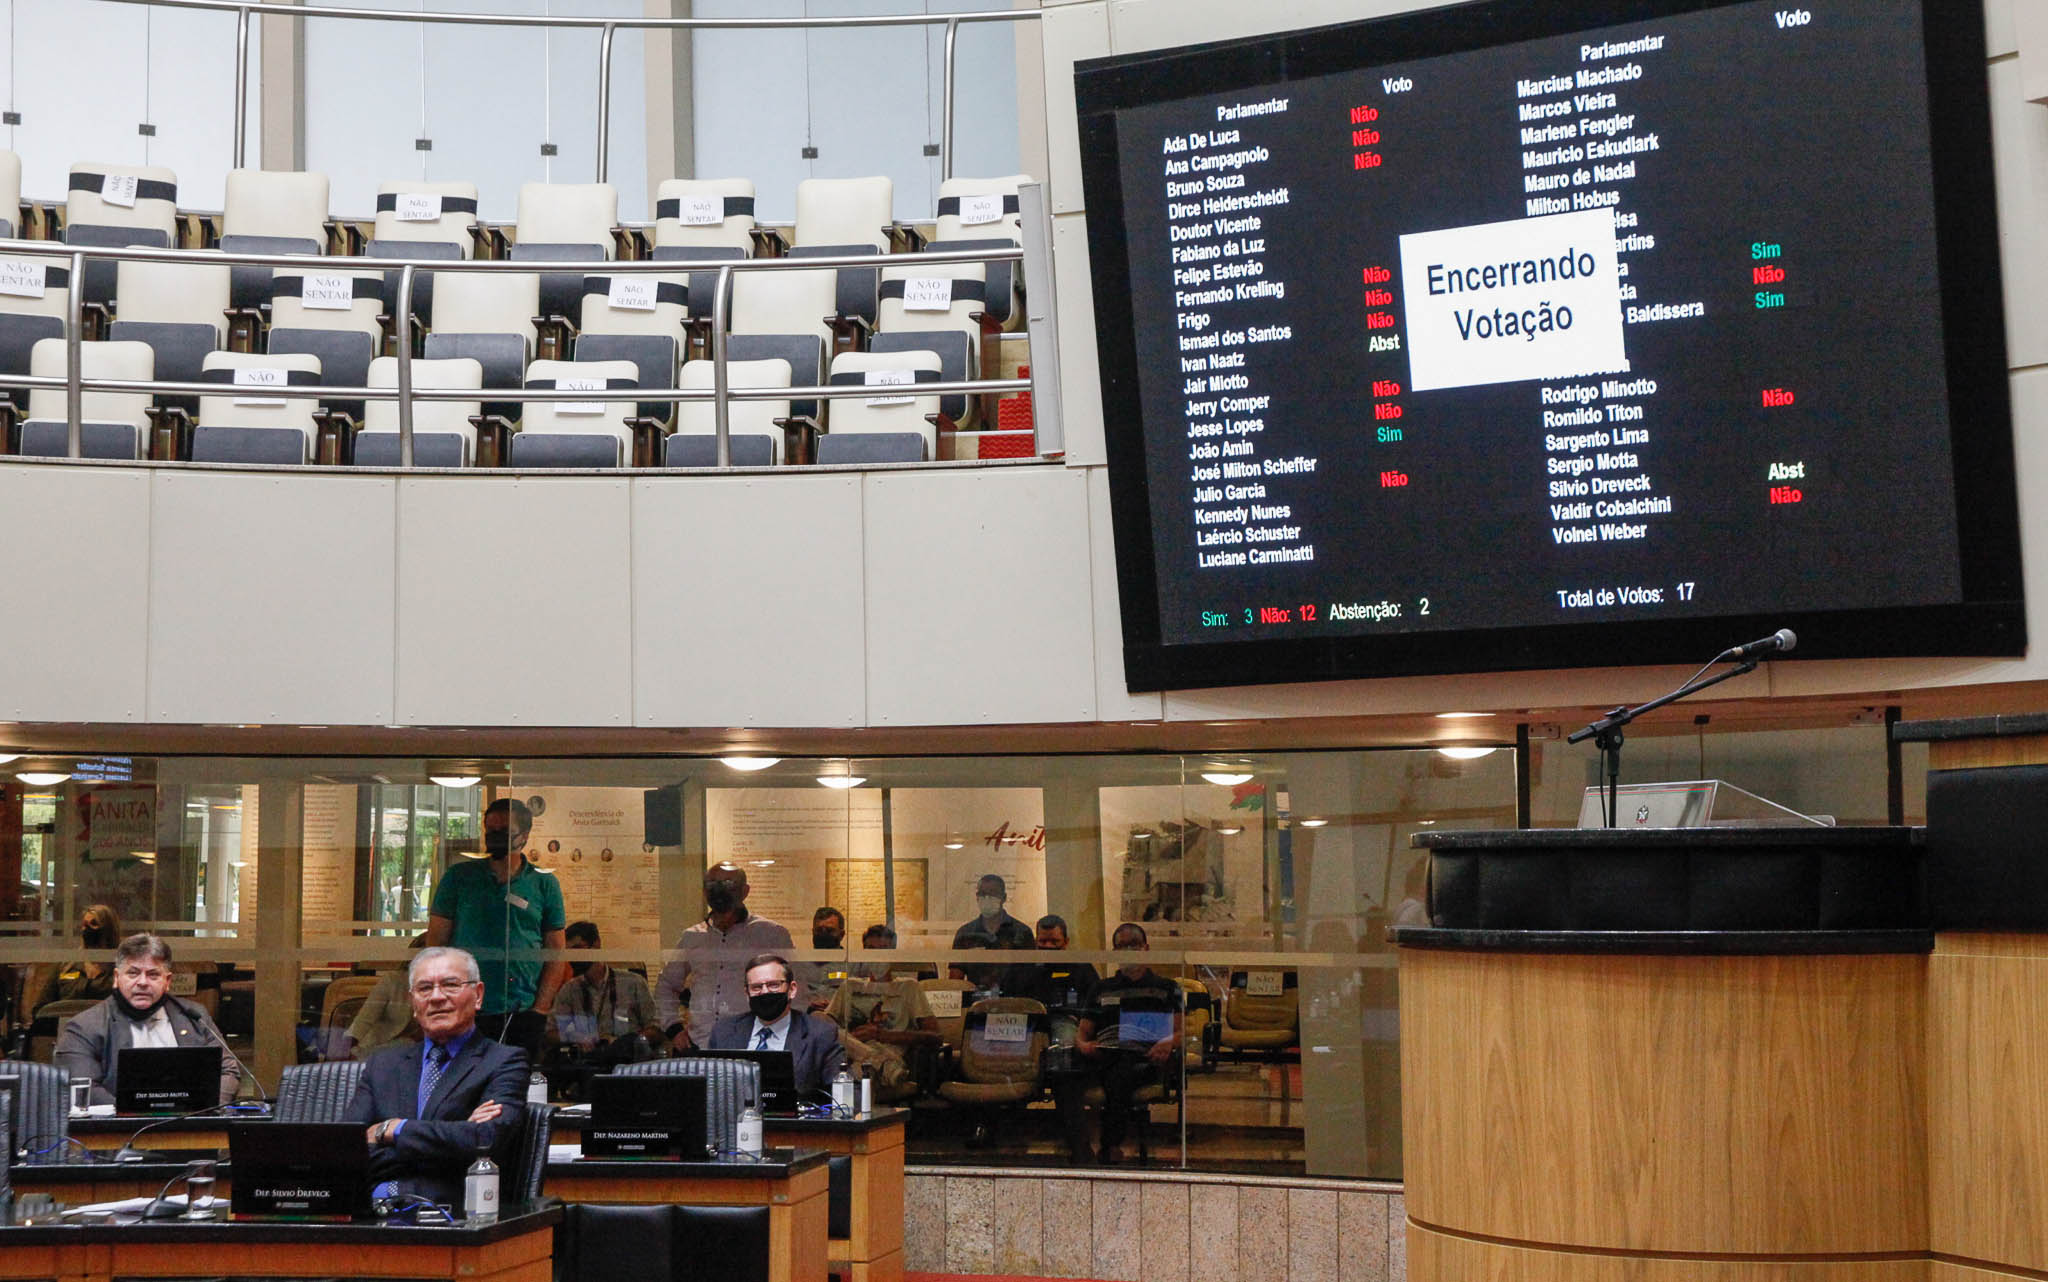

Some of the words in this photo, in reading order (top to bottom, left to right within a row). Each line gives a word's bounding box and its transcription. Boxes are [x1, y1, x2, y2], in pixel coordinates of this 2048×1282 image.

[1776, 9, 1811, 28] Voto
[1581, 35, 1664, 62] Parlamentar
[1383, 77, 1412, 94] Voto
[1517, 75, 1573, 98] Marcius
[1576, 63, 1642, 88] Machado
[1217, 98, 1288, 121] Parlamentar
[1350, 105, 1378, 124] Não
[1519, 101, 1571, 121] Marcos
[1573, 92, 1616, 112] Vieira
[1352, 129, 1380, 147] Não
[1520, 124, 1577, 145] Marlene
[1579, 114, 1635, 136] Fengler
[1163, 136, 1187, 154] Ada
[1189, 133, 1207, 150] De
[1209, 130, 1240, 146] Luca
[1586, 133, 1659, 159] Eskudlark
[1165, 160, 1189, 176] Ana
[1191, 146, 1269, 171] Campagnolo
[1354, 152, 1382, 170] Não
[1167, 181, 1204, 197] Bruno
[1206, 174, 1245, 191] Souza
[1524, 174, 1569, 192] Mauro
[1572, 168, 1590, 186] de
[1593, 160, 1635, 183] Nadal
[1168, 203, 1201, 220] Dirce
[1203, 188, 1289, 214] Heiderscheidt
[1526, 195, 1570, 217] Milton
[1573, 190, 1621, 210] Hobus
[1170, 223, 1212, 241] Doutor
[1214, 216, 1261, 235] Vicente
[1172, 245, 1220, 263] Fabiano
[1223, 240, 1239, 256] da
[1241, 238, 1265, 254] Luz
[1616, 234, 1655, 253] artins
[1752, 242, 1780, 259] Sim
[0, 275, 42, 288] ENTAR
[1174, 268, 1210, 286] Felipe
[1213, 259, 1263, 280] Estevão
[1363, 266, 1391, 284] Não
[1427, 247, 1596, 296] Encerrando
[1753, 265, 1785, 284] Não
[315, 277, 341, 288] NÃO
[917, 280, 941, 290] NÃO
[305, 289, 349, 300] SENTAR
[906, 292, 948, 301] SENTAR
[1176, 286, 1233, 307] Fernando
[1236, 281, 1284, 300] Krelling
[1365, 289, 1393, 307] Não
[1755, 292, 1784, 308] Sim
[1178, 312, 1210, 331] Frigo
[1367, 312, 1395, 329] Não
[1454, 301, 1573, 342] Votação
[1626, 302, 1704, 324] Baldissera
[1179, 332, 1219, 351] Ismael
[1222, 330, 1245, 346] dos
[1248, 325, 1291, 343] Santos
[1369, 334, 1400, 352] Abst
[1181, 357, 1206, 372] Ivan
[1209, 352, 1245, 369] Naatz
[248, 372, 275, 383] NÃO
[1183, 378, 1207, 394] Jair
[1209, 374, 1248, 391] Miotto
[1372, 380, 1400, 397] Não
[1541, 385, 1599, 404] Rodrigo
[1601, 378, 1657, 398] Minotto
[1762, 388, 1795, 407] Não
[1185, 401, 1217, 417] Jerry
[1220, 396, 1269, 413] Comper
[1374, 403, 1403, 420] Não
[1543, 407, 1602, 428] Romildo
[1605, 404, 1643, 422] Titon
[1187, 422, 1223, 438] Jesse
[1225, 419, 1264, 436] Lopes
[1377, 427, 1402, 442] Sim
[1189, 442, 1219, 459] João
[1222, 439, 1253, 457] Amin
[1544, 431, 1610, 452] Sargento
[1612, 428, 1649, 445] Lima
[1191, 463, 1220, 481] José
[1223, 462, 1261, 478] Milton
[1263, 456, 1317, 475] Scheffer
[1547, 455, 1593, 476] Sergio
[1596, 452, 1638, 470] Motta
[1768, 461, 1805, 480] Abst
[1381, 470, 1408, 487] Não
[1549, 480, 1589, 497] Silvio
[1591, 474, 1651, 494] Dreveck
[1193, 486, 1222, 503] Julio
[1225, 483, 1266, 500] Garcia
[1770, 486, 1802, 504] Não
[1194, 506, 1248, 525] Kennedy
[1251, 505, 1290, 520] Nunes
[1550, 503, 1593, 520] Valdir
[1596, 496, 1671, 517] Cobalchini
[1197, 529, 1243, 546] Laércio
[1245, 525, 1301, 542] Schuster
[1552, 525, 1597, 544] Volnei
[1599, 523, 1647, 540] Weber
[1199, 551, 1246, 567] Luciane
[1249, 545, 1313, 564] Carminatti
[1557, 589, 1593, 608] Total
[1596, 589, 1614, 605] de
[1617, 587, 1664, 604] Votos:
[1677, 582, 1694, 600] 17
[1202, 611, 1228, 626] Sim:
[1245, 608, 1252, 624] 3
[1261, 608, 1291, 623] Não:
[1299, 604, 1316, 621] 12
[1330, 601, 1401, 621] Abstenção:
[1420, 598, 1429, 615] 2
